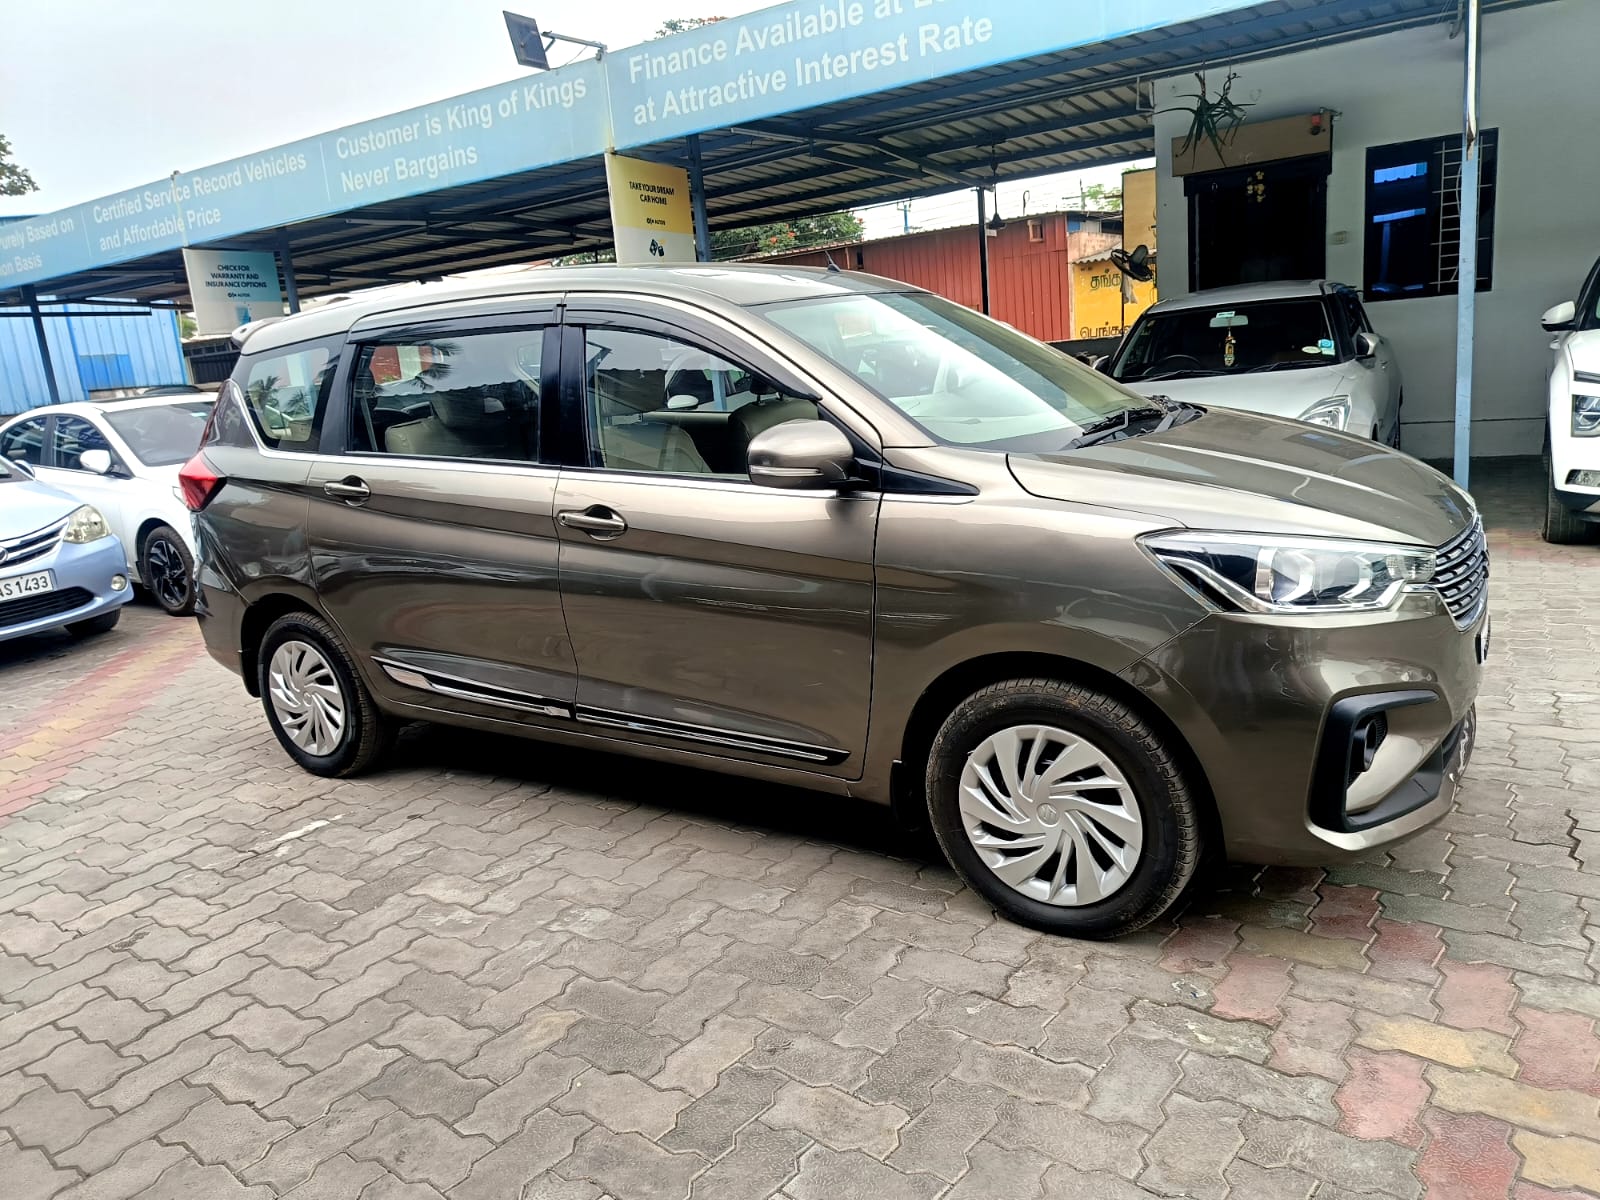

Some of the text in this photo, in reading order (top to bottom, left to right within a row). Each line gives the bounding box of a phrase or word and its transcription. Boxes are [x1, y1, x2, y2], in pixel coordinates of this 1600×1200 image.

[629, 39, 728, 84] Finance
[734, 2, 864, 56] Available
[634, 16, 993, 126] at Attractive Interest Rate
[336, 77, 588, 159] Customer is King of Kings
[93, 151, 307, 224] Certified Service Record Vehicles
[340, 144, 478, 193] Never Bargains
[629, 181, 641, 190] TAKE
[0, 217, 75, 250] urely Based on
[100, 206, 222, 251] and Affordable Price
[14, 251, 43, 273] Basis
[210, 272, 260, 280] WARRANTY AND
[217, 264, 250, 272] CHECK FOR
[205, 280, 240, 288] INSURANCE
